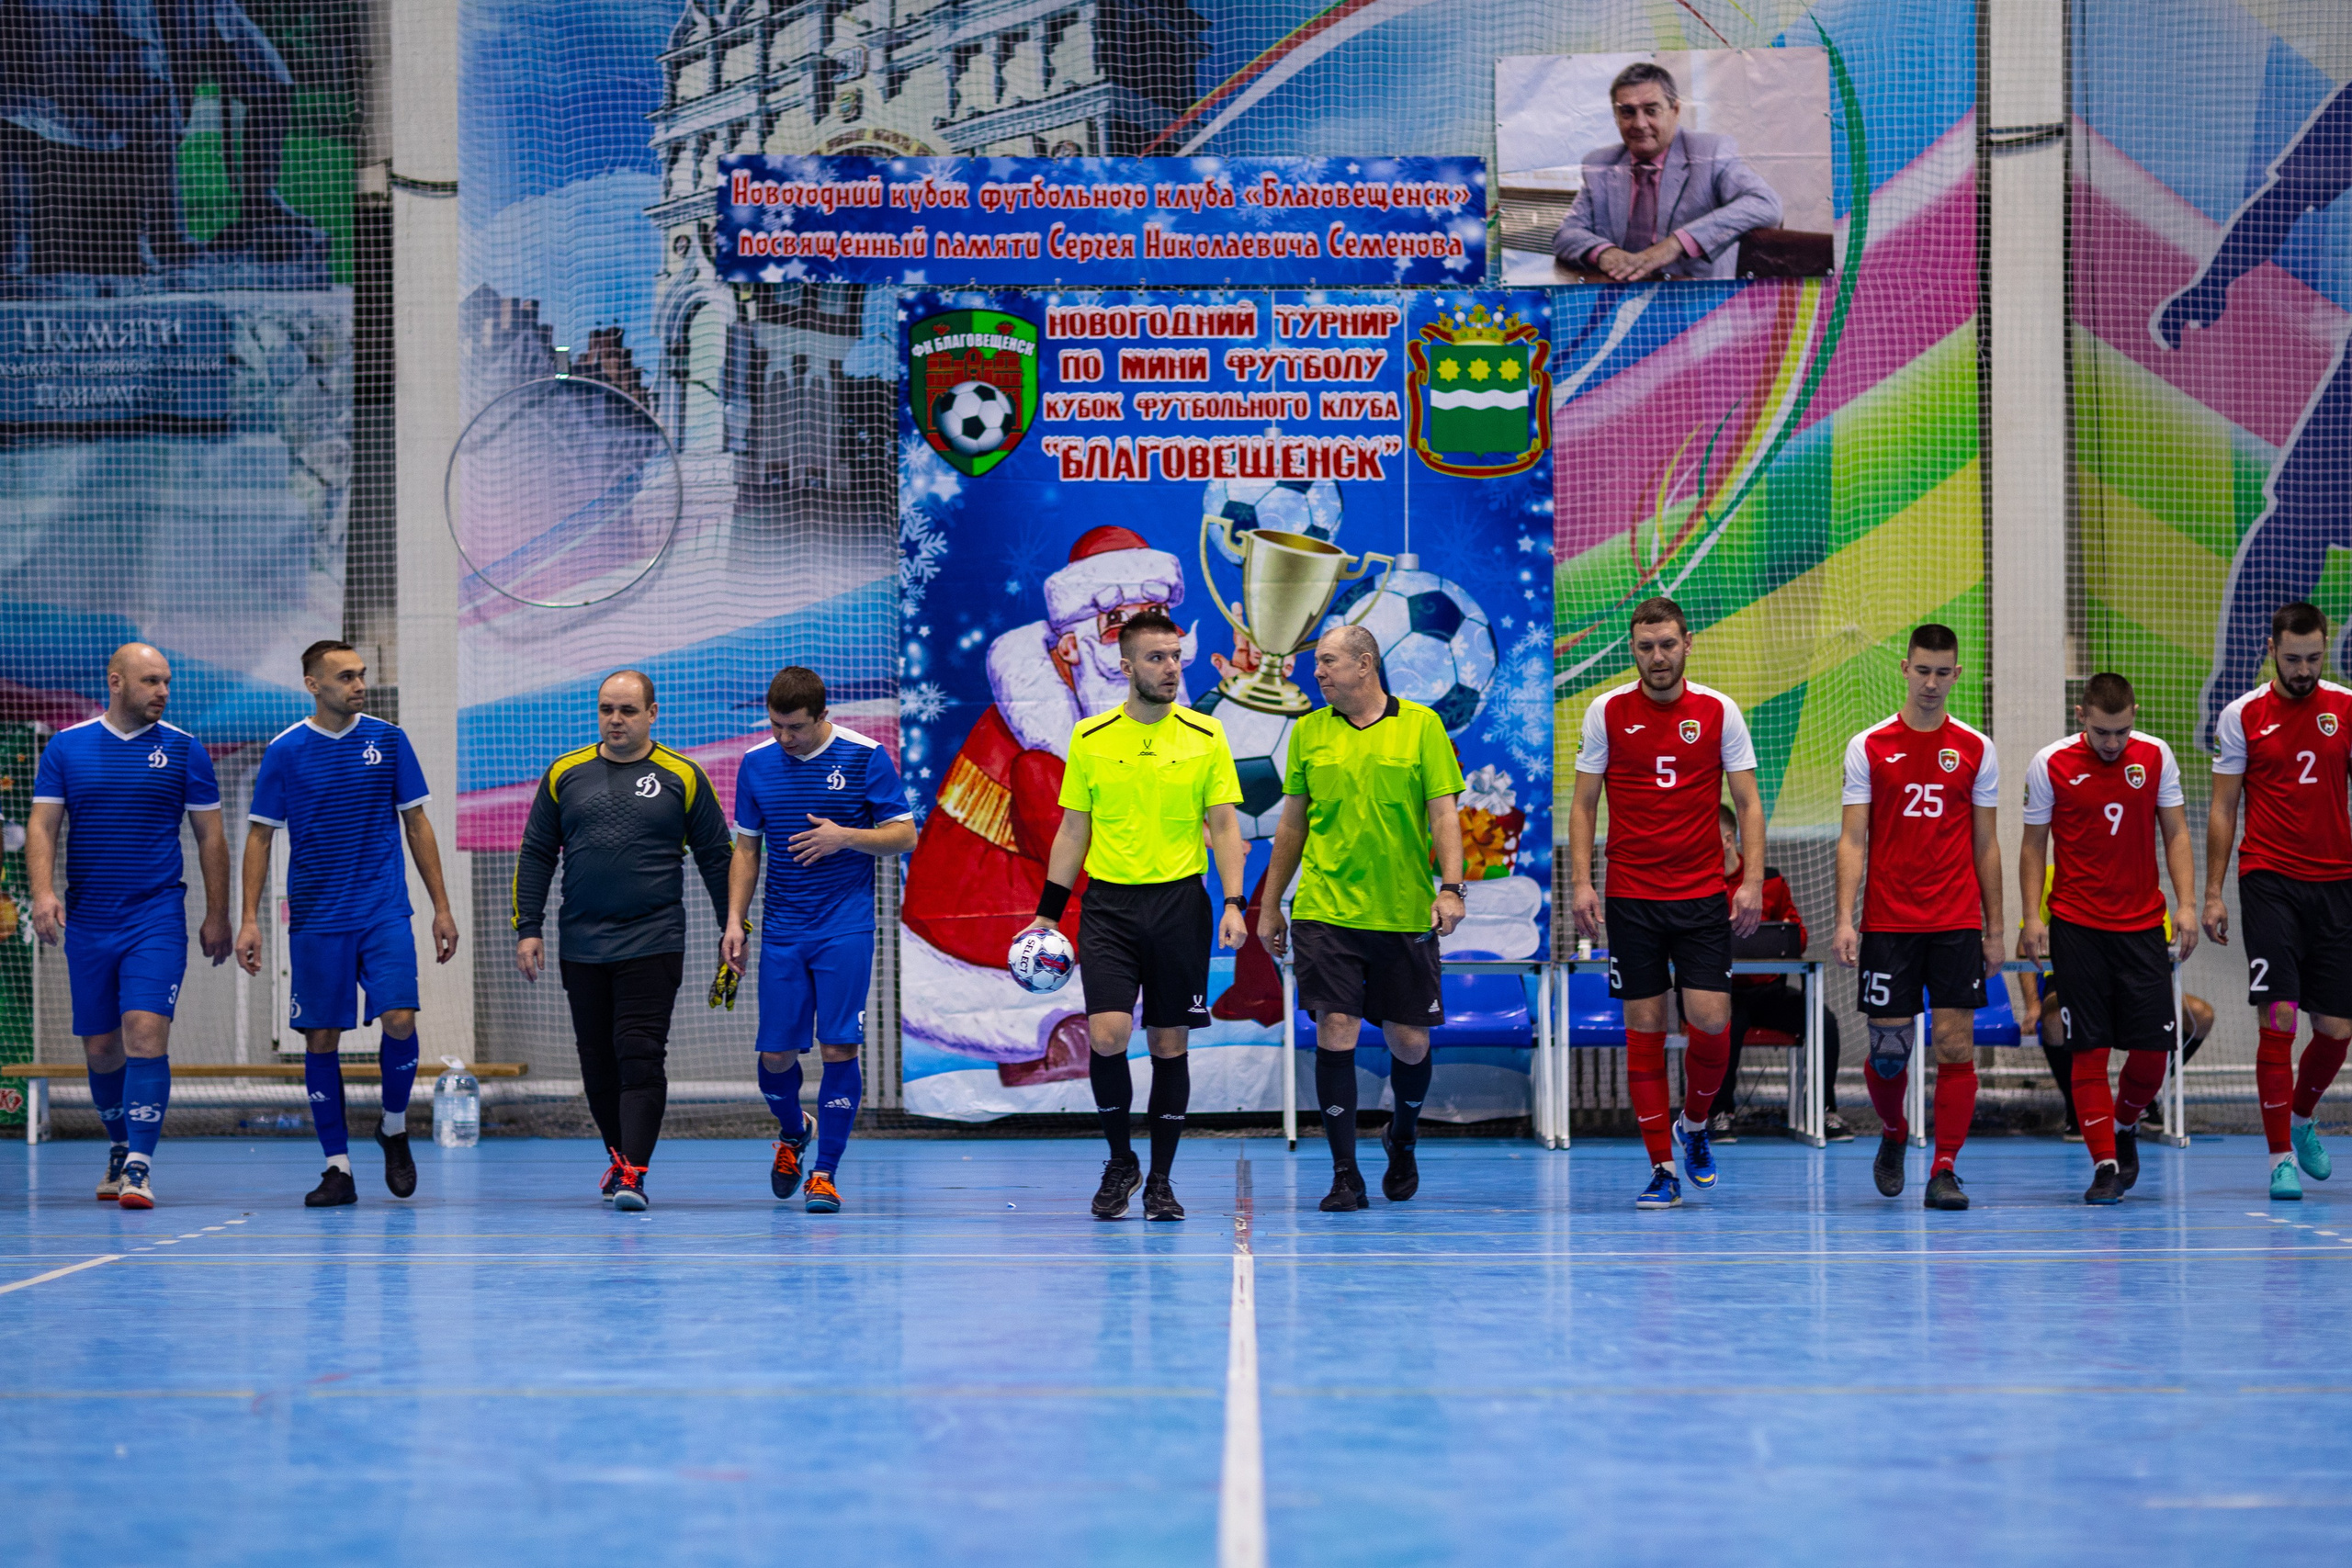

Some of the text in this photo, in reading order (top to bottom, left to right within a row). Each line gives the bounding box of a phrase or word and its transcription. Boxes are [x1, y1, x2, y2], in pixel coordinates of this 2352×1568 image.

[731, 169, 1472, 215] Новогодний кубок футбольного клуба «Благовещенск»
[738, 220, 1464, 264] посвященный памяти Сергея Николаевича Семенова
[1046, 300, 1400, 339] НОВОГОДНИЙ ТУРНИР
[910, 333, 1035, 357] ФК БЛАГОВЕЩЕНСК
[1059, 348, 1387, 382] ПО МИНИ ФУТБОЛУ
[1043, 391, 1401, 421] КУБОК ФУТБОЛЬНОГО КЛУБА
[1656, 756, 1677, 788] 5
[2296, 750, 2318, 784] 2
[1903, 784, 1944, 818] 25
[2104, 802, 2124, 836] 9
[1019, 938, 1036, 975] SELECT
[1610, 956, 1623, 988] 5
[1862, 969, 1893, 1007] 25
[2250, 958, 2270, 992] 2
[168, 984, 178, 1005] 3
[2060, 1006, 2072, 1040] 9
